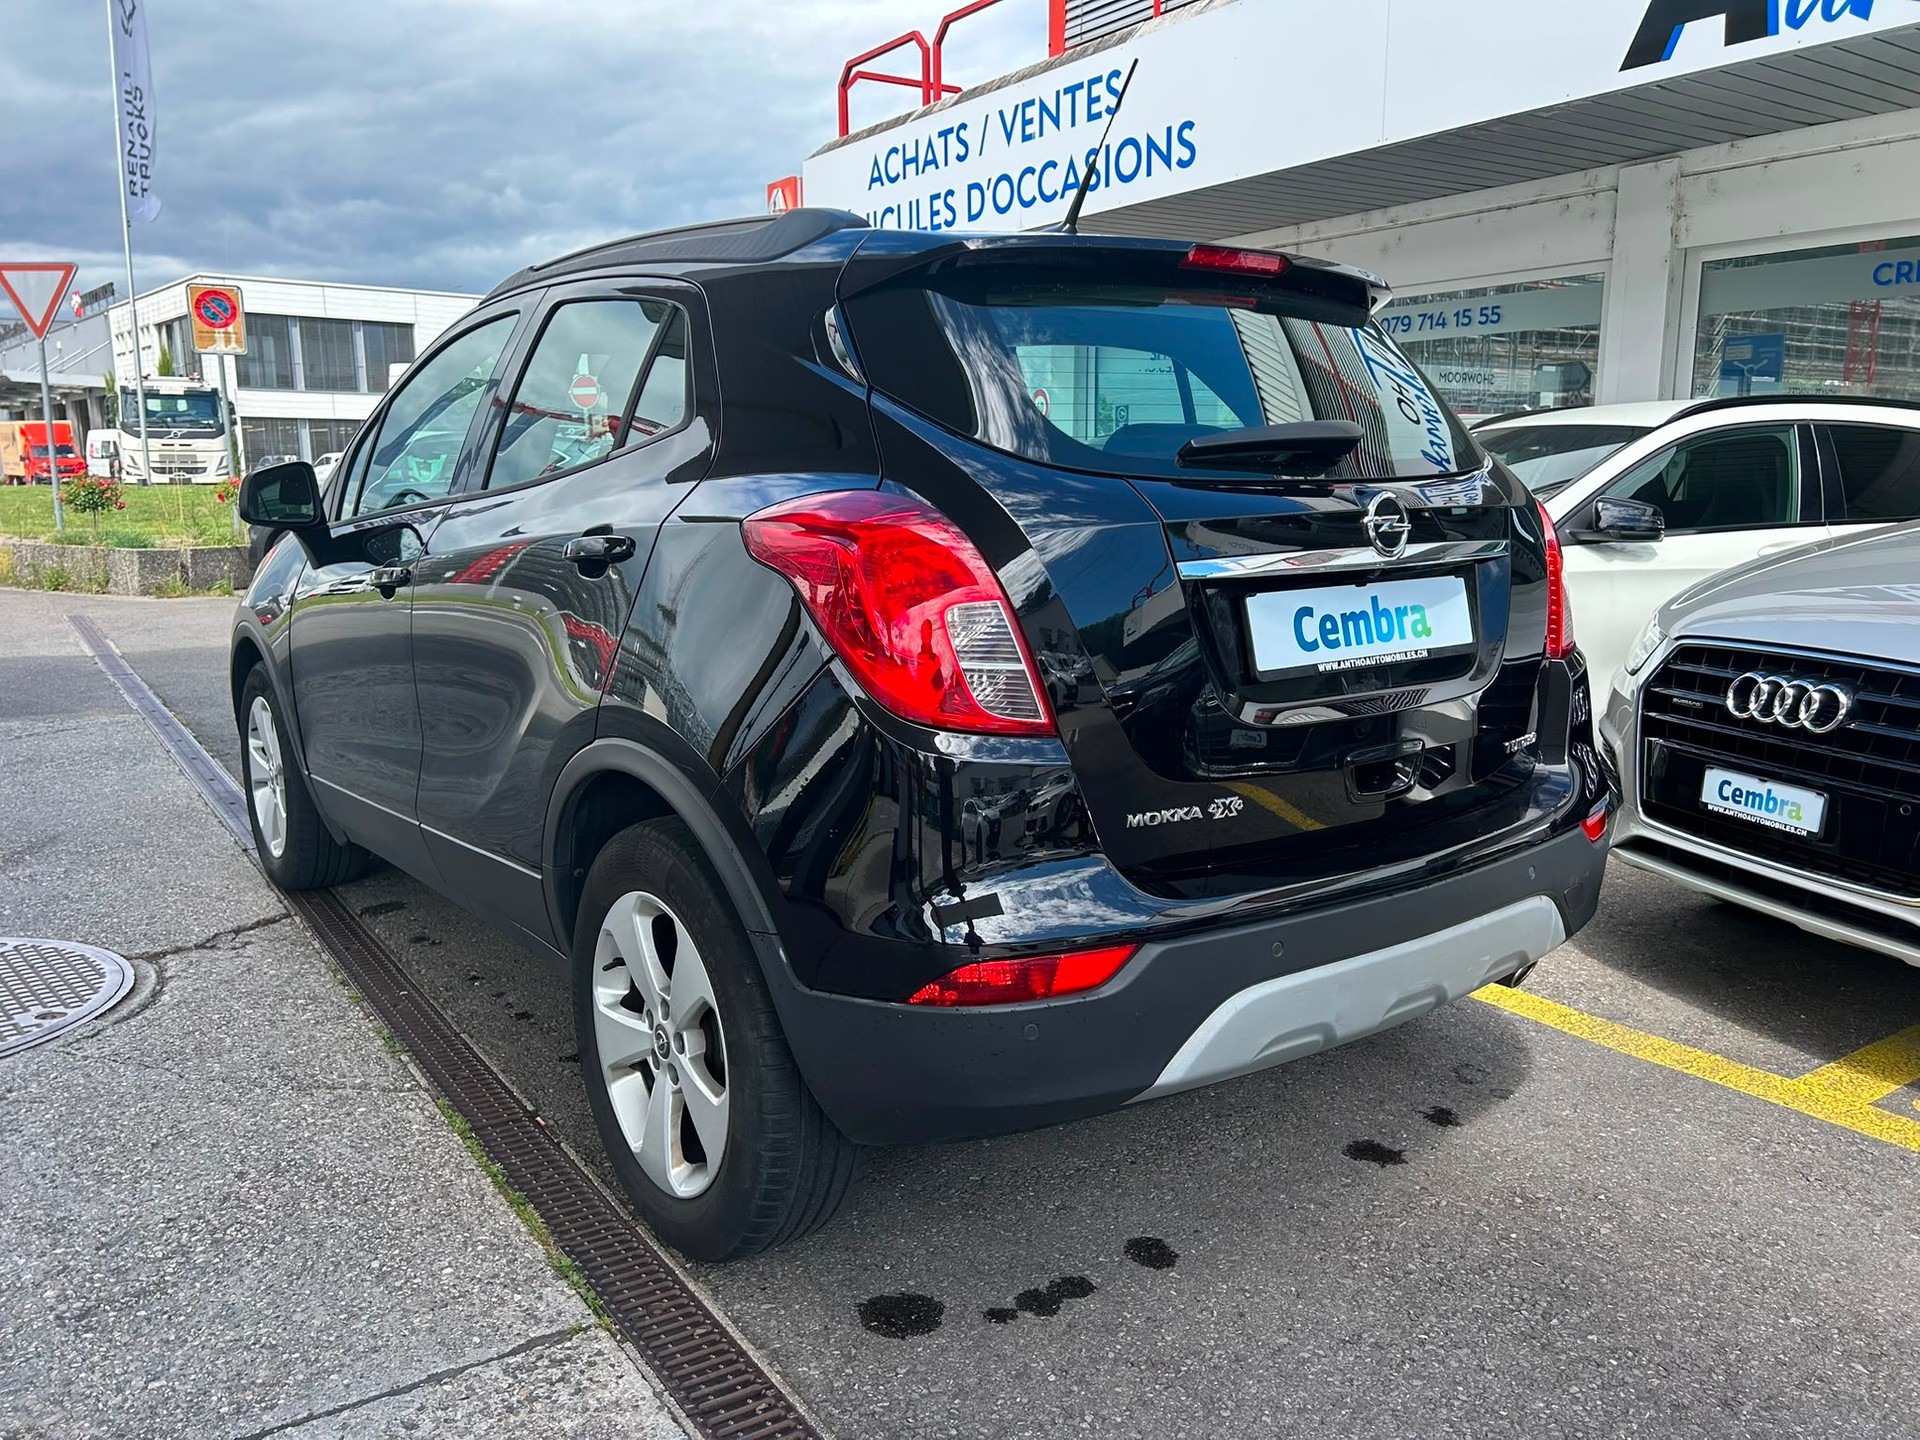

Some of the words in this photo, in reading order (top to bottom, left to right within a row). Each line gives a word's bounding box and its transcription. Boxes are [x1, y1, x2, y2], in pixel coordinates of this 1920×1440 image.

[868, 122, 969, 191] ACHATS
[978, 113, 989, 157] /
[998, 69, 1122, 148] VENTES
[967, 120, 1196, 223] D'OCCASIONS
[1380, 314, 1412, 334] 079
[1416, 311, 1447, 331] 714
[1453, 308, 1472, 328] 15
[1477, 304, 1502, 325] 55
[1293, 595, 1432, 653] Cembra
[1318, 649, 1428, 673] WWW.ANTHOAUTOMOBILES.CH
[1126, 805, 1203, 828] MOKKA
[1717, 779, 1803, 822] Cembra
[1707, 804, 1808, 837] WWW.ANTHOAUTOMOBILES.CH
